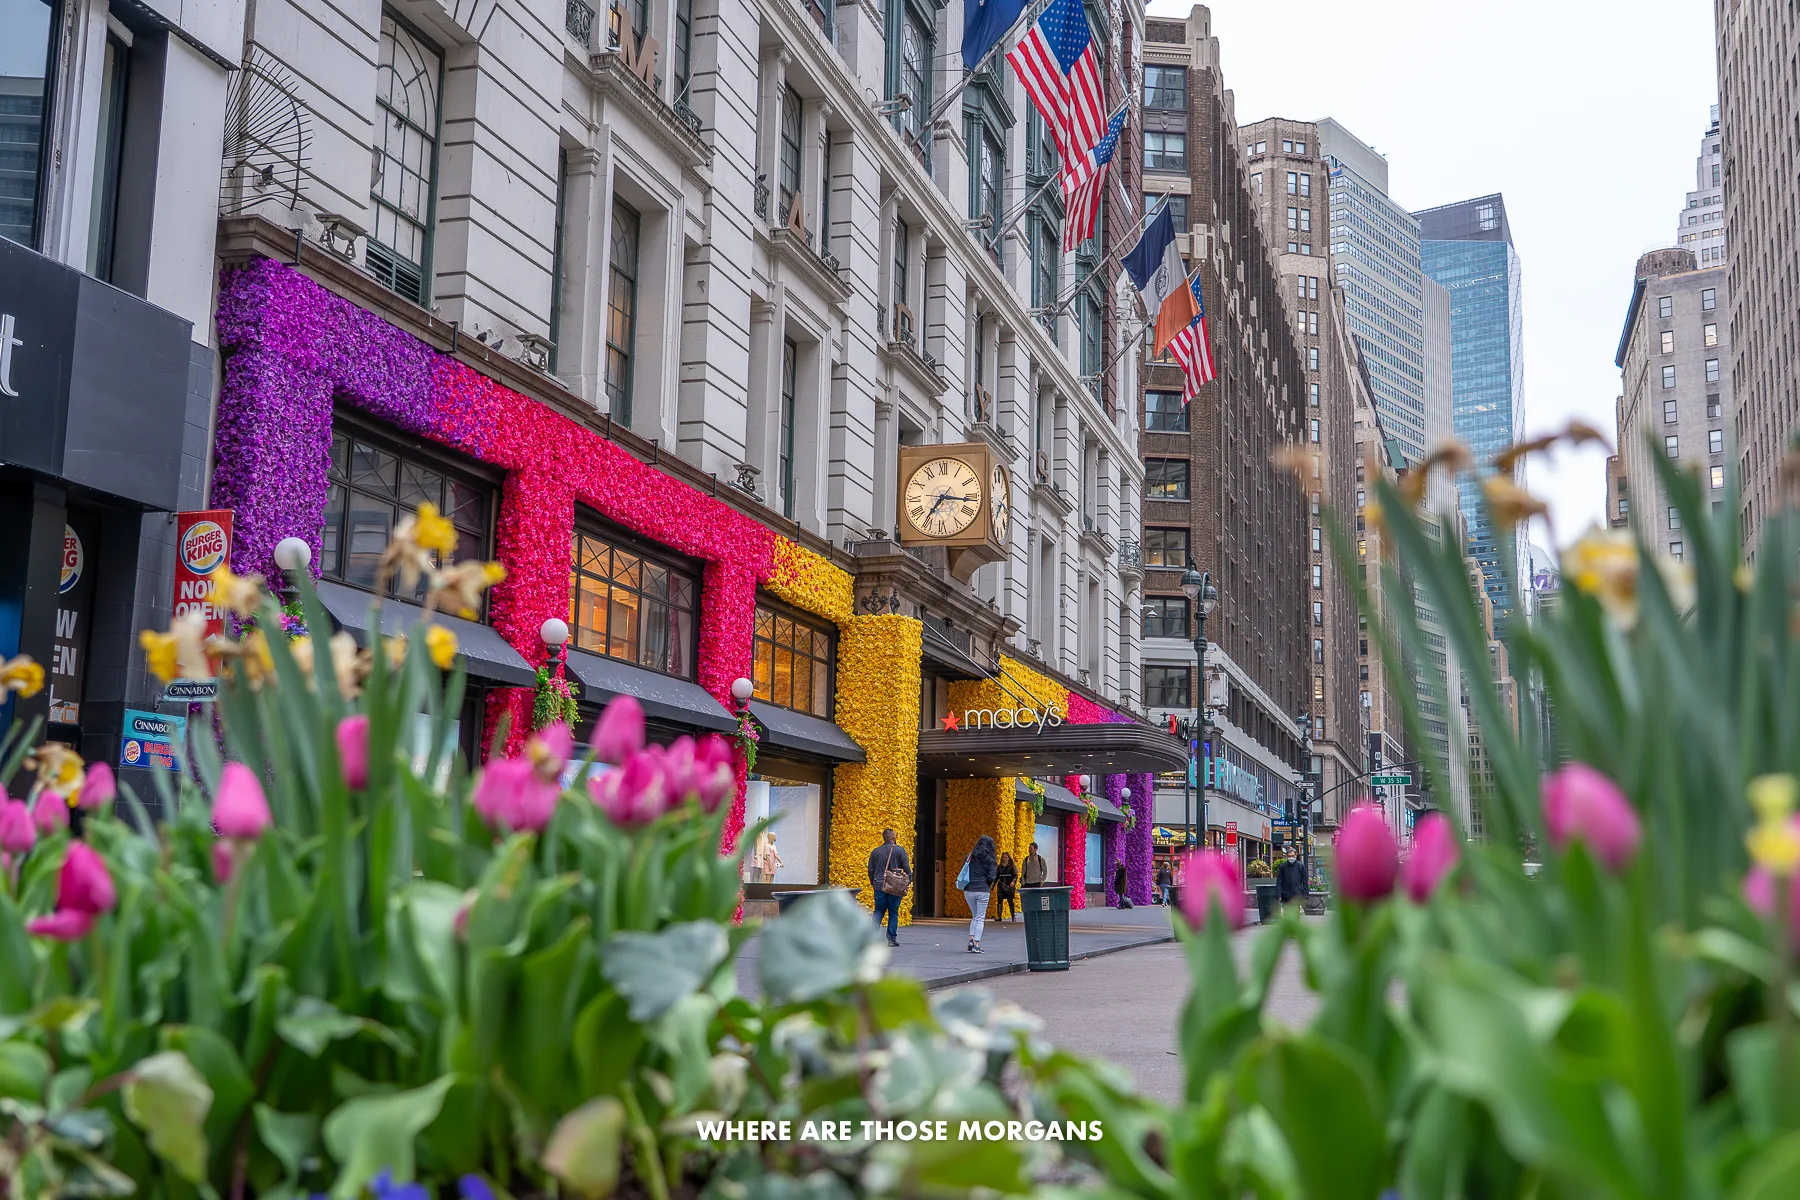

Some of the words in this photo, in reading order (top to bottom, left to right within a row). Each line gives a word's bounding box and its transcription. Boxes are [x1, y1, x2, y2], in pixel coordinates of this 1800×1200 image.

[186, 530, 221, 550] BURGER
[187, 540, 222, 563] KING
[169, 686, 215, 695] CINNABON
[965, 700, 1061, 734] macy's
[134, 720, 171, 732] CINNABO
[144, 742, 176, 756] BURGE
